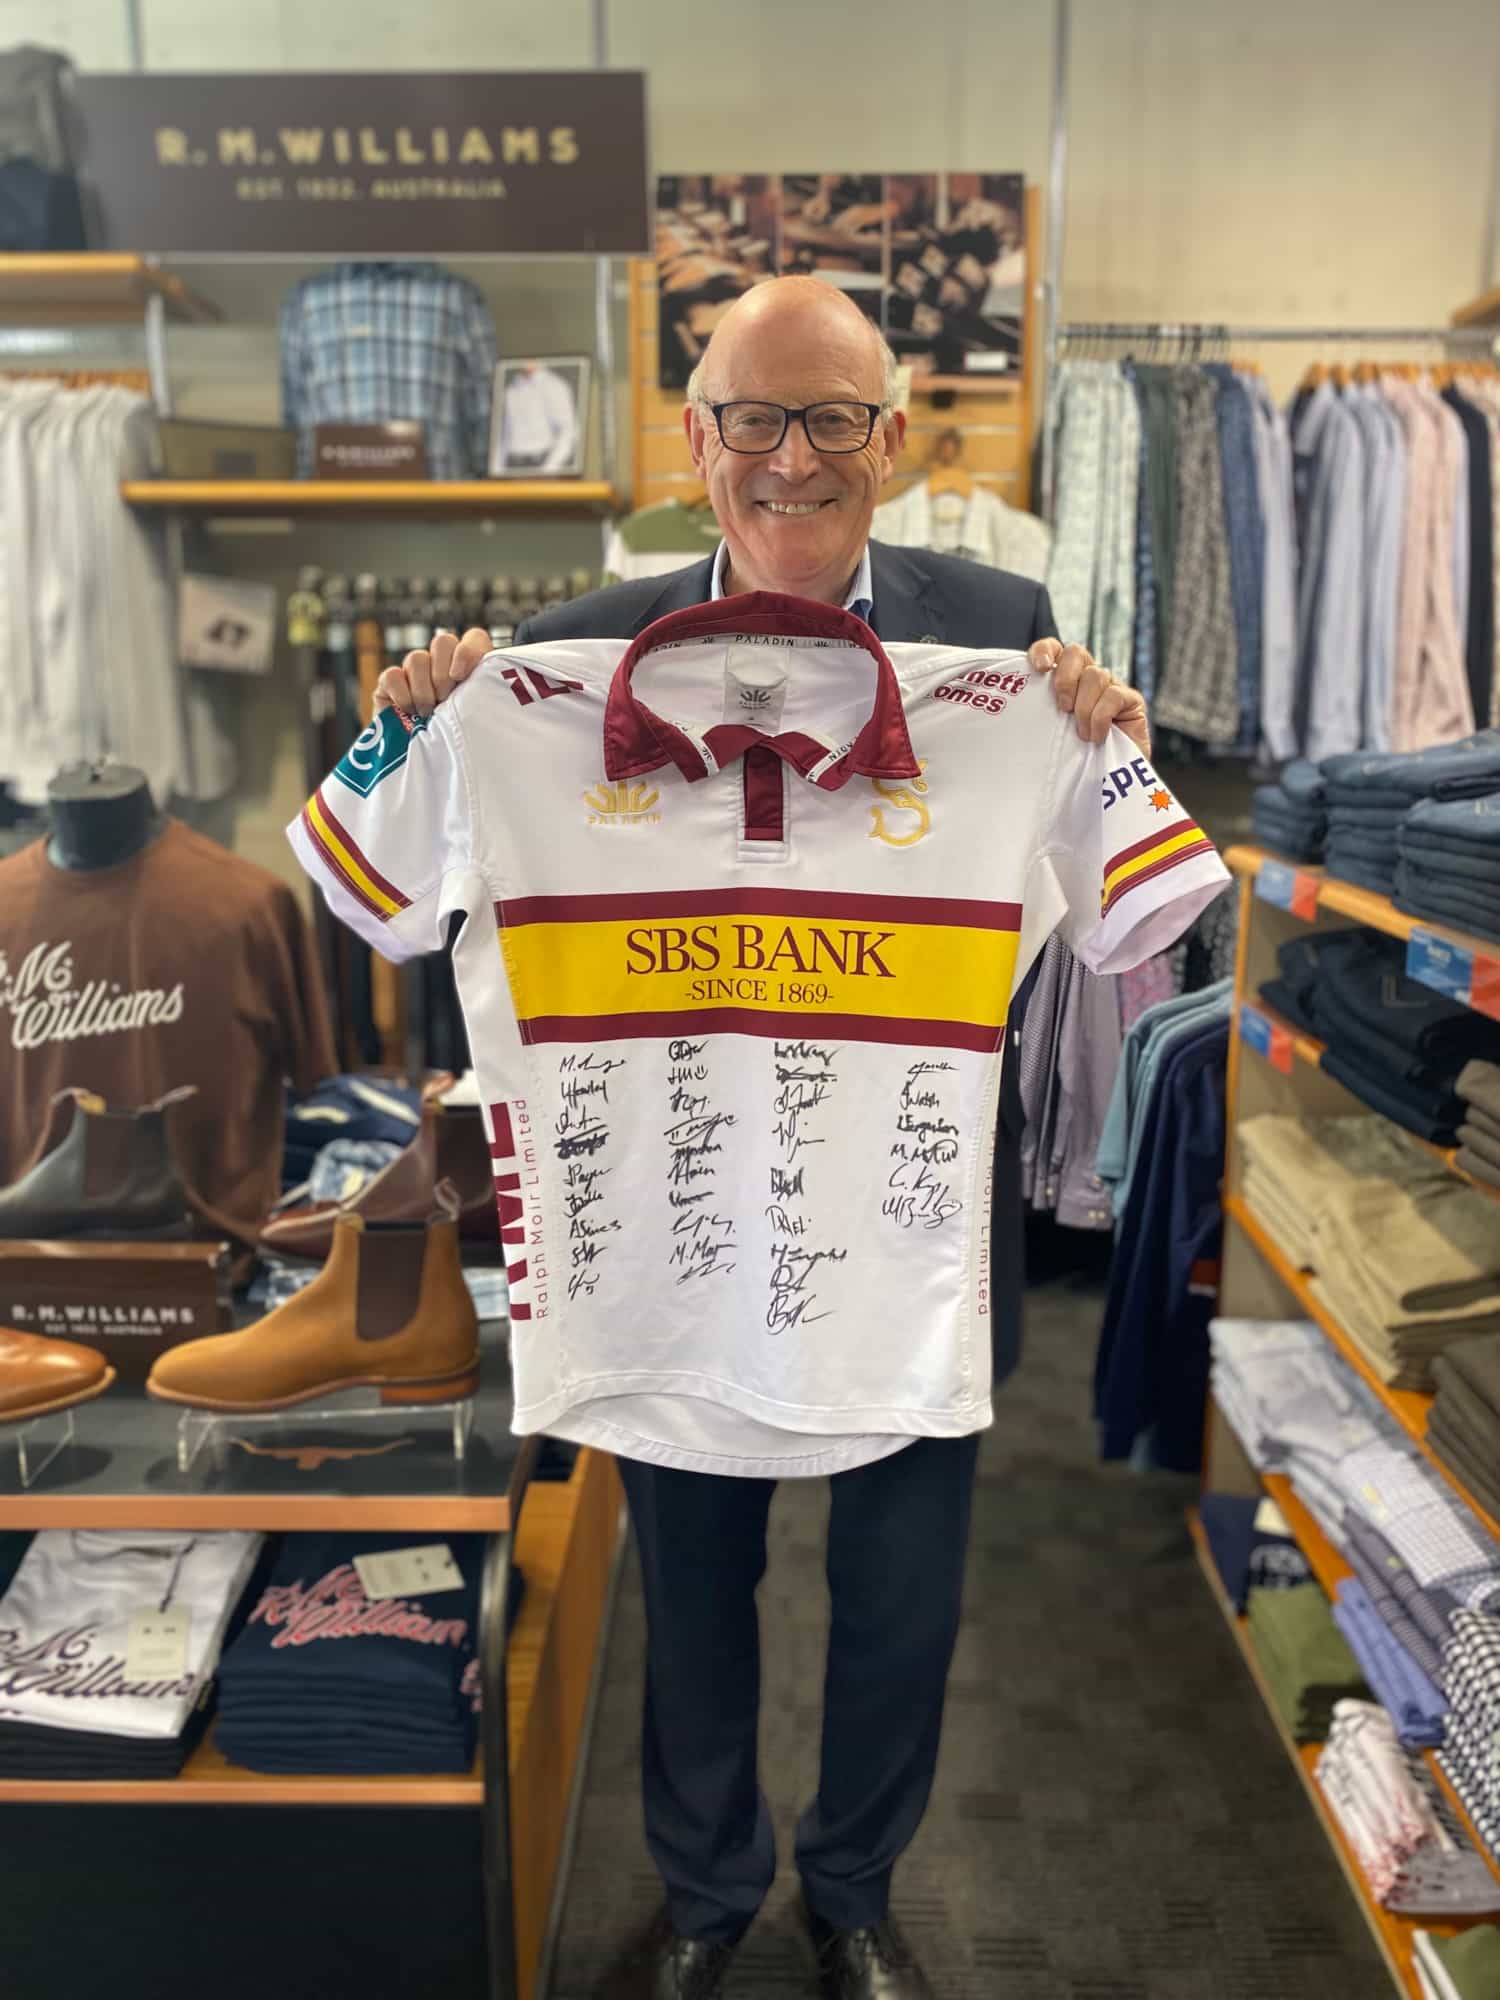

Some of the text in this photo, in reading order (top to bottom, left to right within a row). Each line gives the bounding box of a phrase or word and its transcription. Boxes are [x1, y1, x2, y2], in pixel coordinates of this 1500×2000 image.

[735, 634, 795, 647] PALADIN
[626, 924, 897, 978] SBS BANK
[10, 978, 185, 1049] Williams
[511, 1099, 549, 1320] Ralph Moir Limited
